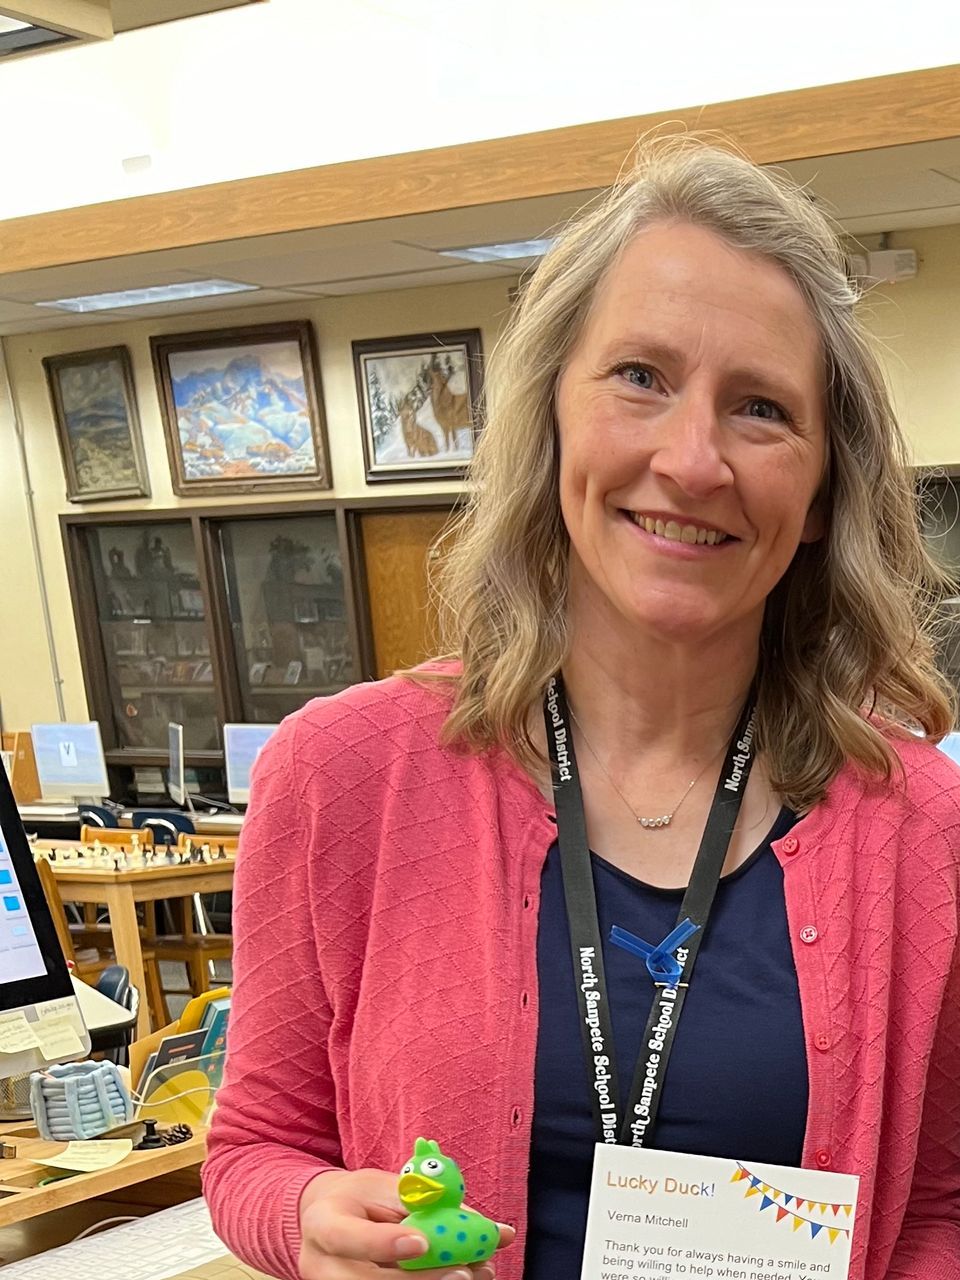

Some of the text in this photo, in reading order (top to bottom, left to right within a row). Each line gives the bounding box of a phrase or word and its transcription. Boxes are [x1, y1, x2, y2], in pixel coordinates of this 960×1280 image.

[547, 677, 573, 782] School District
[724, 752, 751, 792] North
[579, 946, 617, 1144] North Sanpete School Dist
[634, 1054, 660, 1116] Sanpete
[648, 998, 676, 1052] School
[607, 1171, 714, 1196] Lucky Duck!
[645, 1214, 688, 1228] Mitchell
[603, 1255, 634, 1270] being
[638, 1259, 672, 1274] willing
[676, 1262, 686, 1272] to
[690, 1264, 713, 1278] help
[717, 1267, 746, 1279] when
[605, 1240, 830, 1272] Thank you for always having a smile and
